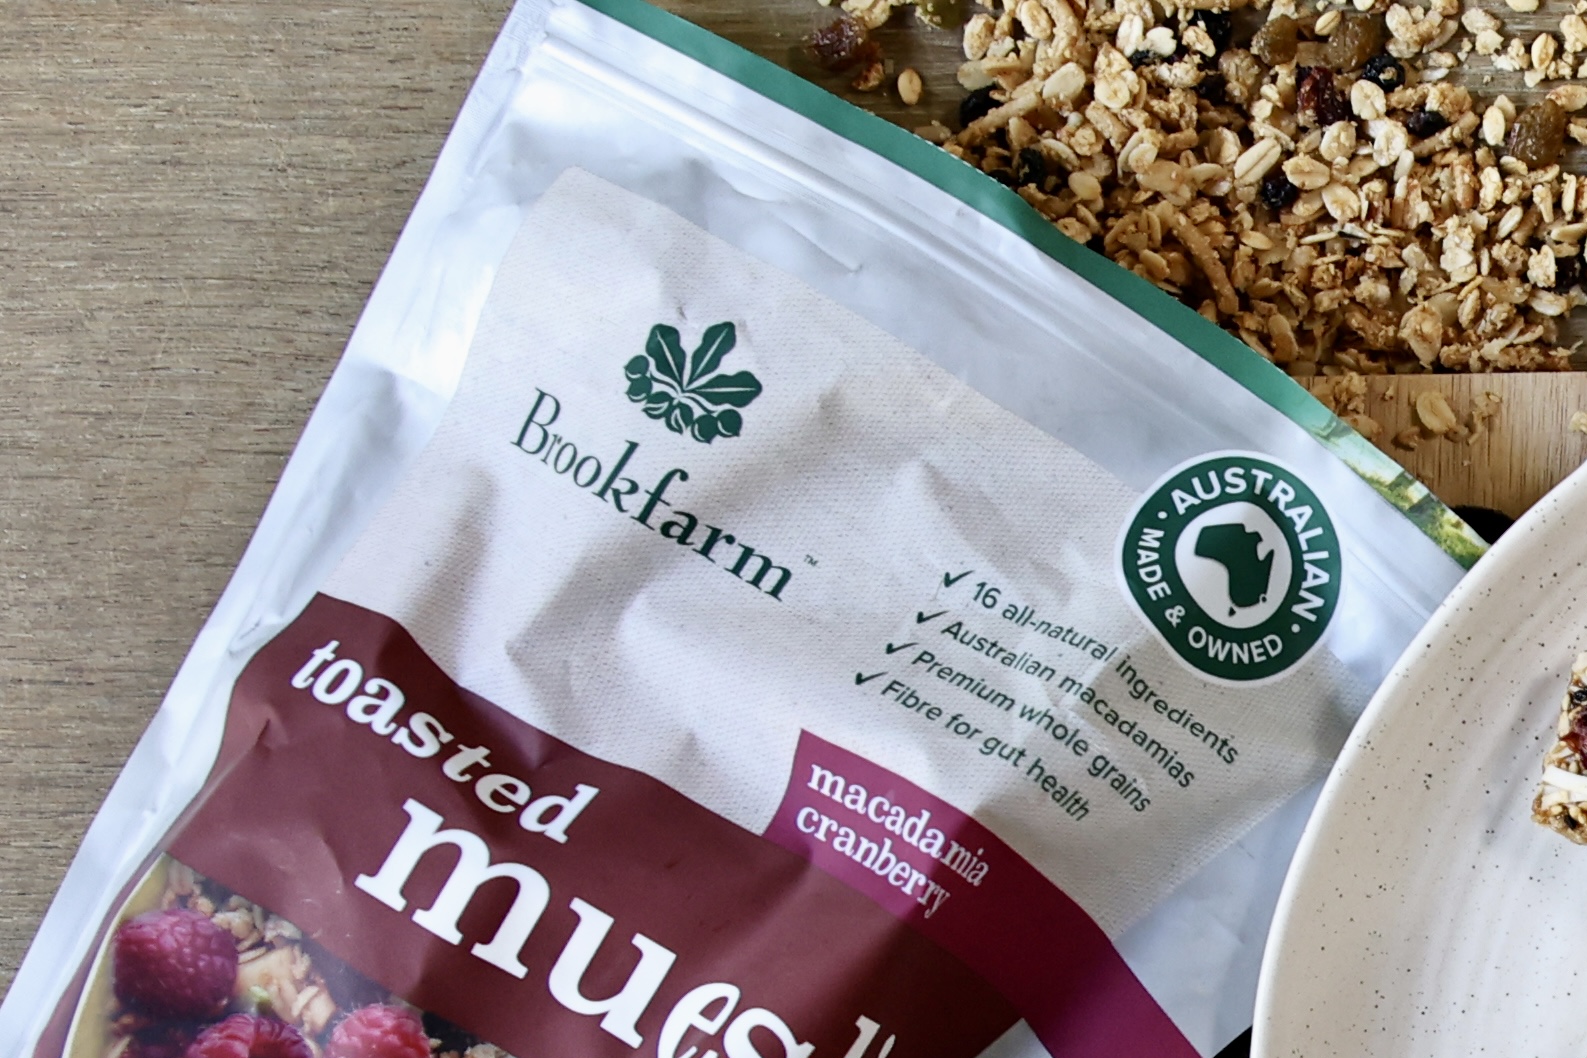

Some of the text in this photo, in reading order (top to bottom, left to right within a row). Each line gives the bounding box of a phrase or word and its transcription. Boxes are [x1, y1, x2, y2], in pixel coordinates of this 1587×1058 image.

[510, 386, 793, 602] Brookfarm
[1171, 466, 1331, 623] AUSTRALIAN
[973, 581, 1239, 766] 16 all-natural ingredients
[1136, 527, 1283, 665] MADE & OWNED
[290, 640, 600, 844] toasted
[881, 680, 1090, 822] Fibre for gut health
[912, 650, 1152, 813] Premium whole grains
[941, 620, 1196, 789] Australian macadamias
[796, 806, 951, 919] cranberry
[807, 763, 989, 887] macadamia
